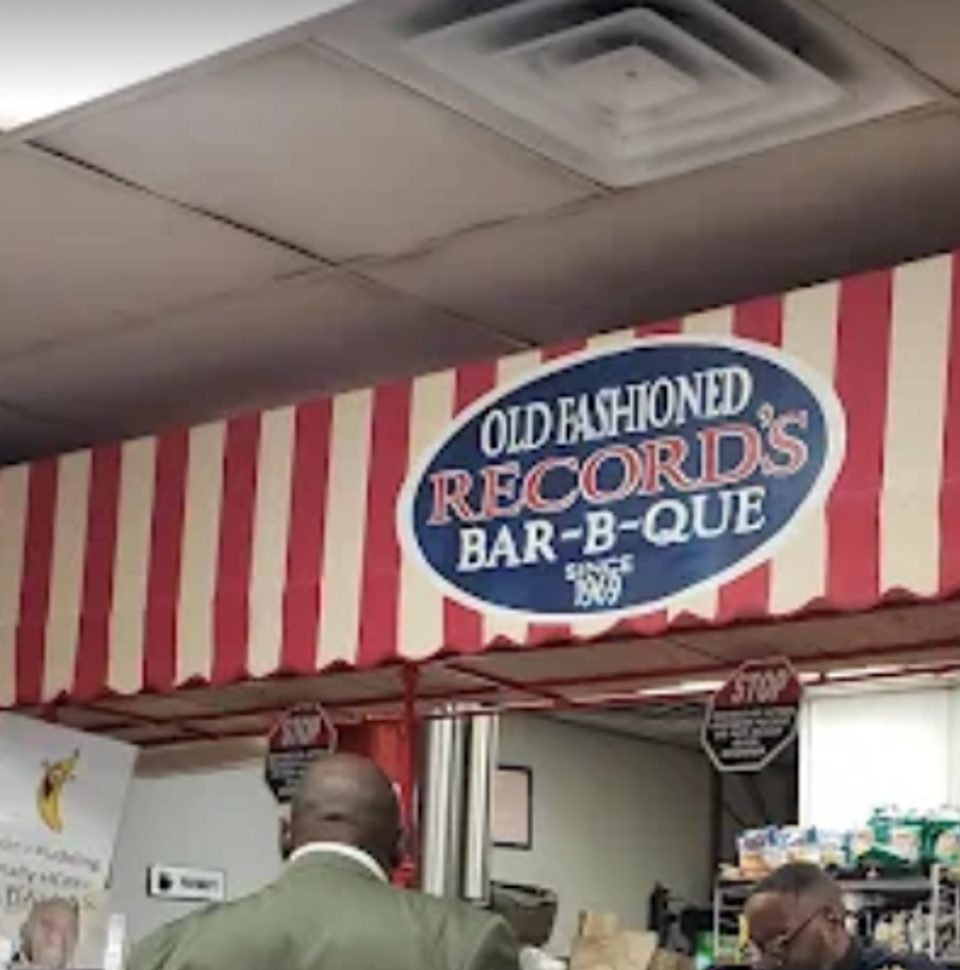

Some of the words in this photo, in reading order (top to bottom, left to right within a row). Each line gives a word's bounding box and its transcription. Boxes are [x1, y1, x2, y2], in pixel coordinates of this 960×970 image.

[480, 401, 552, 459] OLD
[557, 366, 754, 446] FASHIONED
[426, 403, 810, 526] RECORD'S
[457, 486, 767, 573] BAR-B-QUE
[729, 668, 788, 704] STOP
